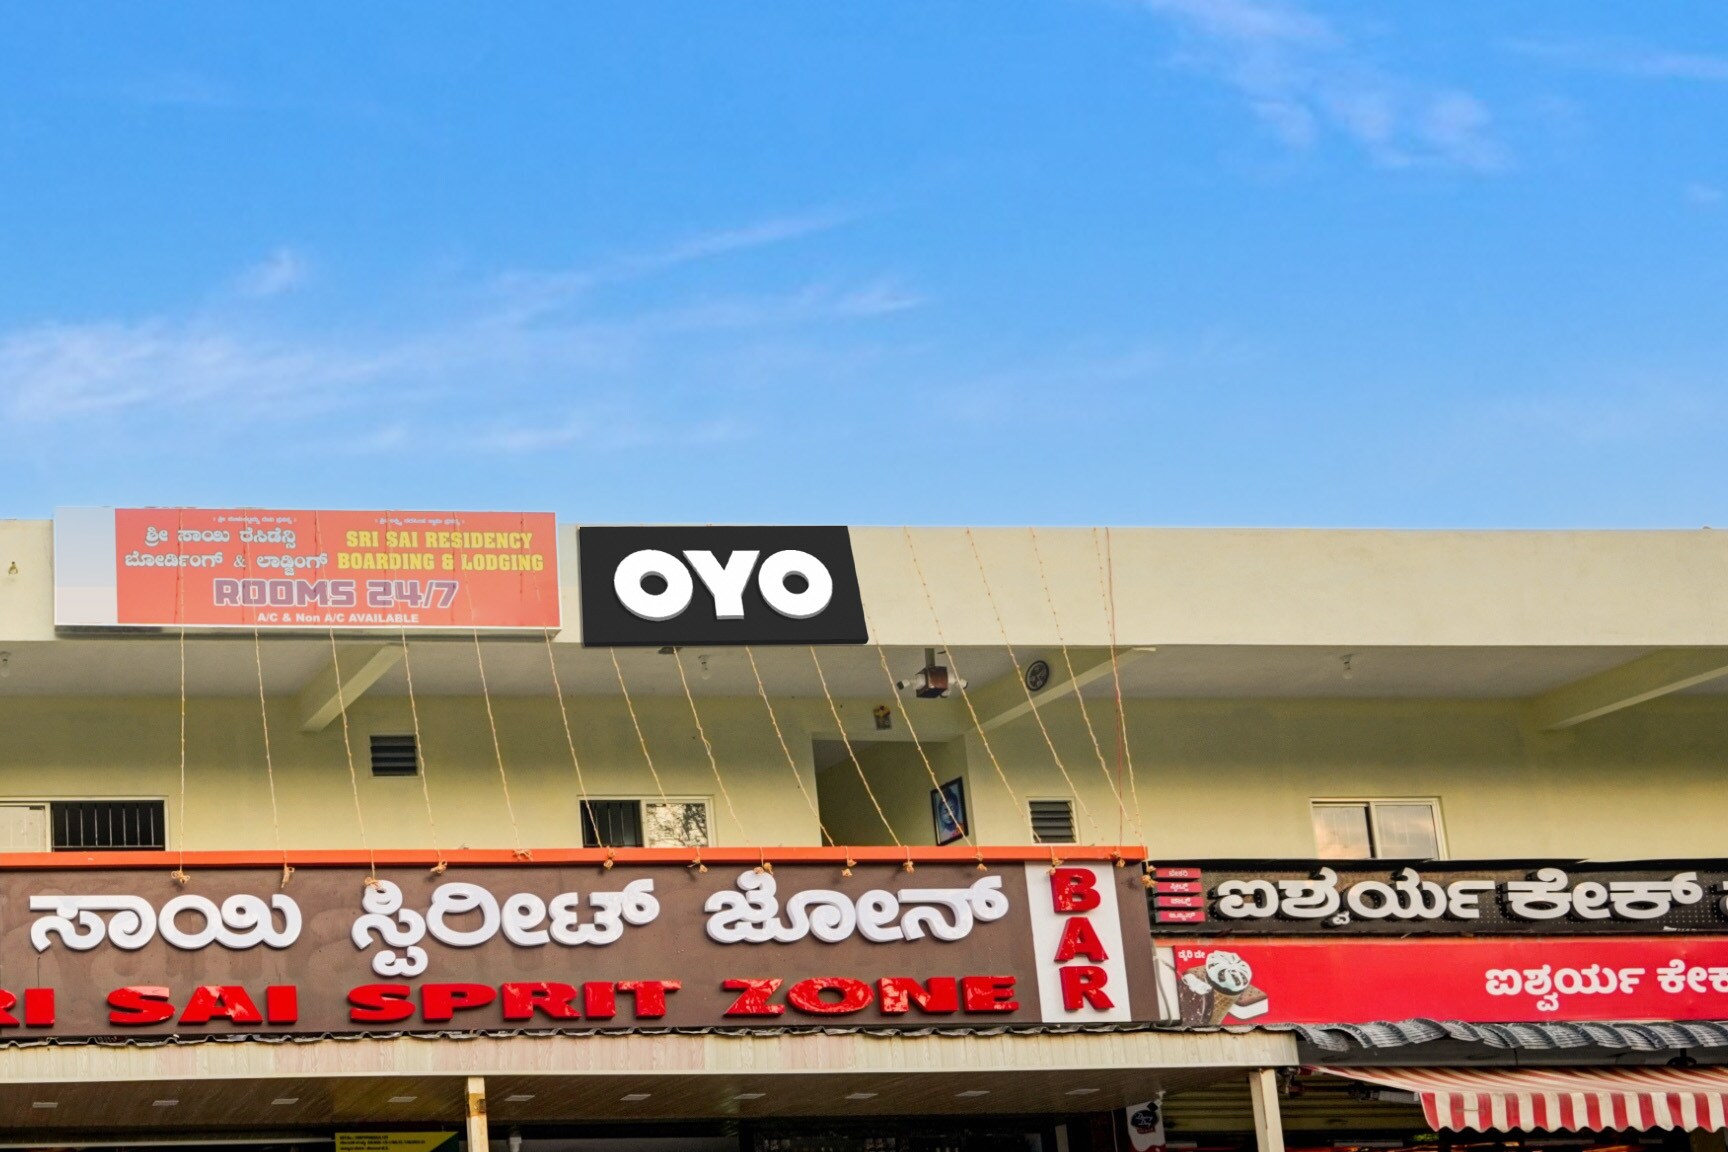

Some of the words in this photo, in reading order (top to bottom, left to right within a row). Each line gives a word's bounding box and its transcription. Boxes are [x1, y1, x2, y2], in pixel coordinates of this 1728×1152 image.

[145, 526, 169, 547] ಶ್ರೀ
[177, 528, 230, 543] ಸಾಯಿ
[346, 530, 379, 548] SRI
[386, 531, 419, 548] SAI
[425, 531, 533, 549] RESIDENCY
[233, 554, 247, 568] &
[337, 552, 435, 570] BOARDING
[441, 554, 454, 570] &
[461, 553, 545, 571] LODGING
[213, 577, 357, 607] ROOMS
[366, 579, 459, 609] 24/7
[613, 549, 833, 621] OYO
[257, 612, 278, 623] A/C
[282, 612, 292, 622] &
[296, 613, 321, 623] Non
[324, 613, 345, 623] A/C
[348, 613, 419, 623] AVAILABLE
[1217, 866, 1496, 926] ಐಶ್ವರ್ಯ
[1507, 868, 1703, 919] ಕೇಕ್
[29, 893, 303, 953] ಸಾಯಿ
[1049, 868, 1115, 1011] BAR
[107, 984, 300, 1027] SAI
[347, 981, 682, 1023] SPRIT
[721, 976, 1020, 1018] ZONE
[1485, 963, 1645, 1012] ಐಶ್ವರ್ಯ
